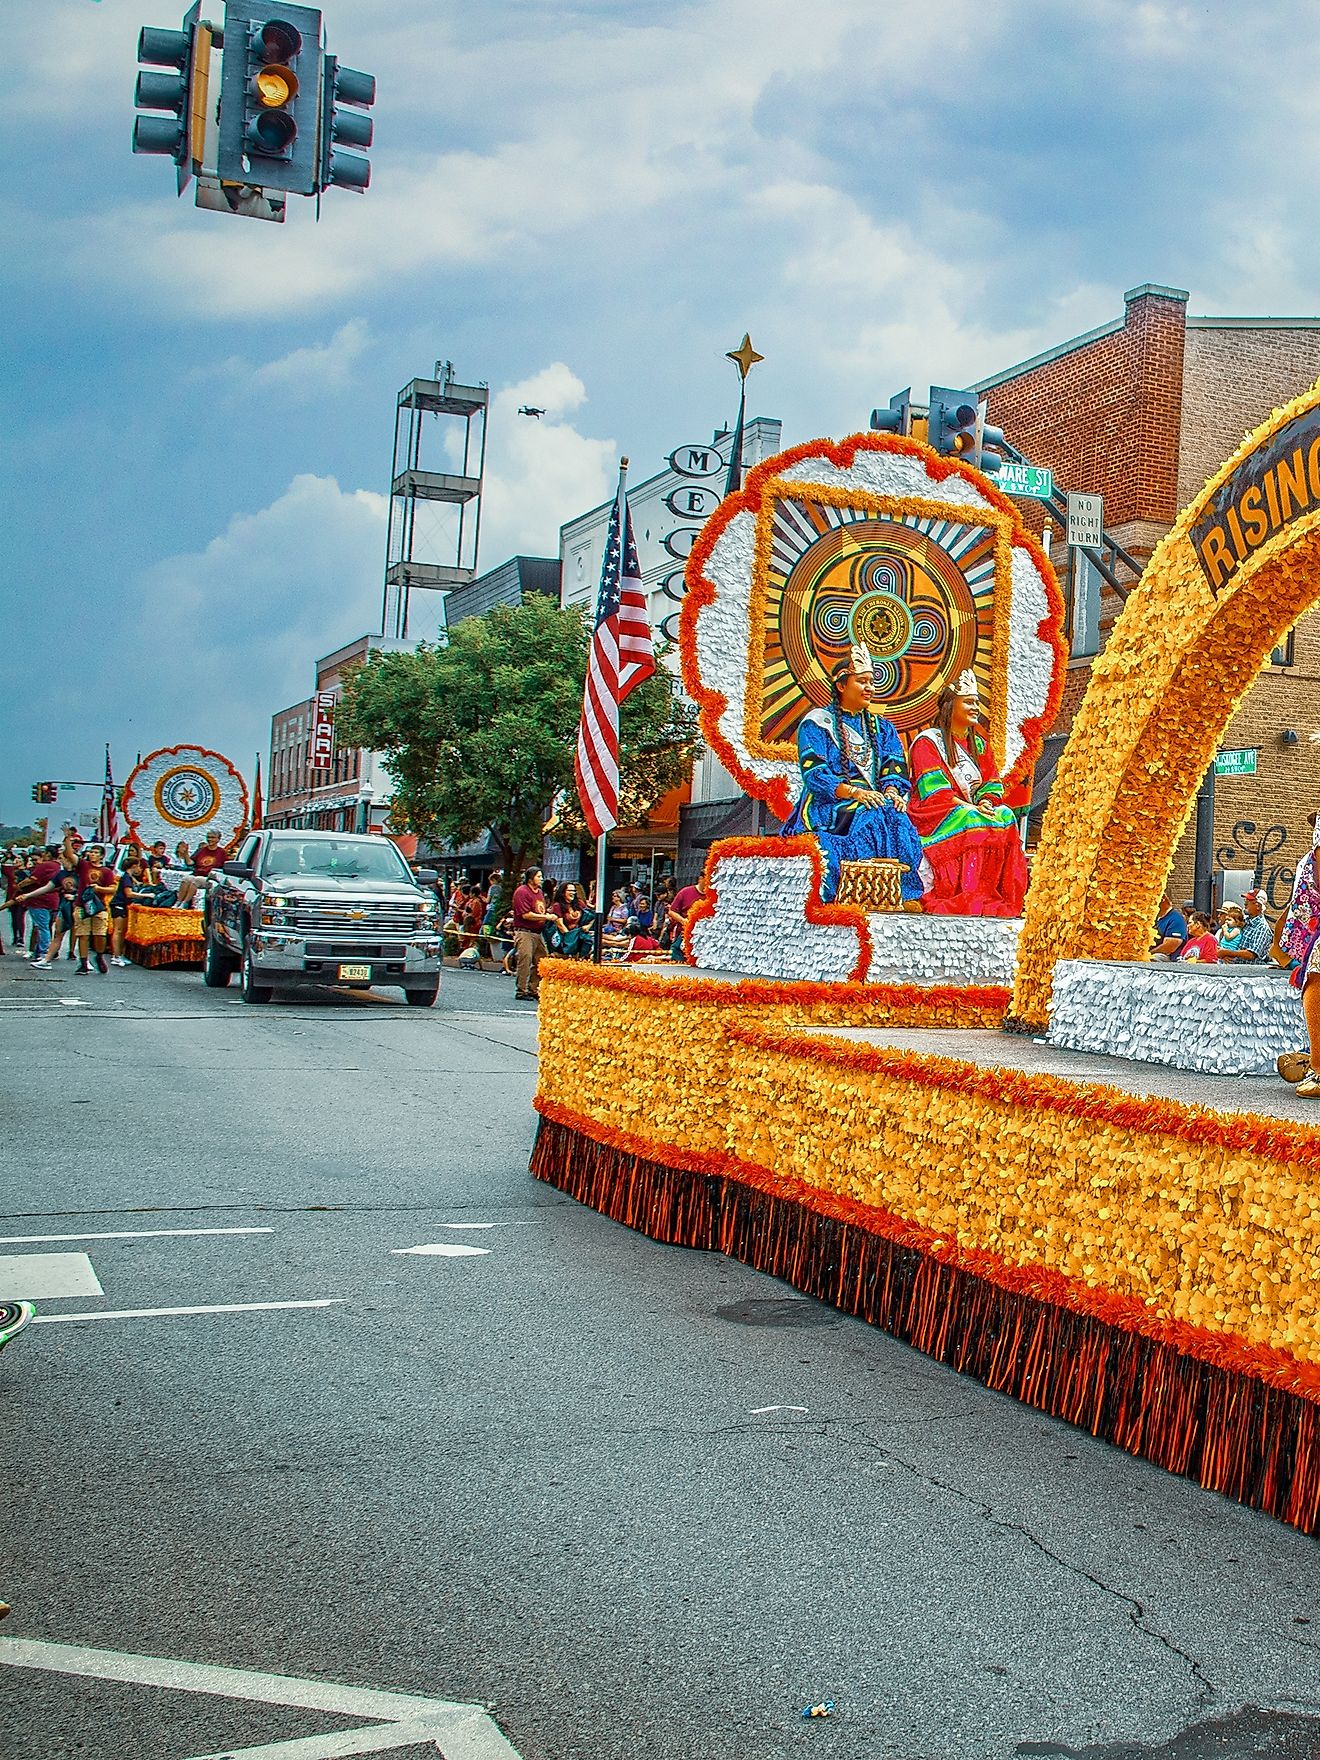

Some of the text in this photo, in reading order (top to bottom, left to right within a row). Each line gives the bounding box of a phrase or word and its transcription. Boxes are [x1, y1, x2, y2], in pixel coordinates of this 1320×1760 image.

[1036, 471, 1048, 487] ST
[1078, 501, 1092, 511] NO
[1070, 516, 1099, 528] RIGHT
[1070, 532, 1099, 544] TURN
